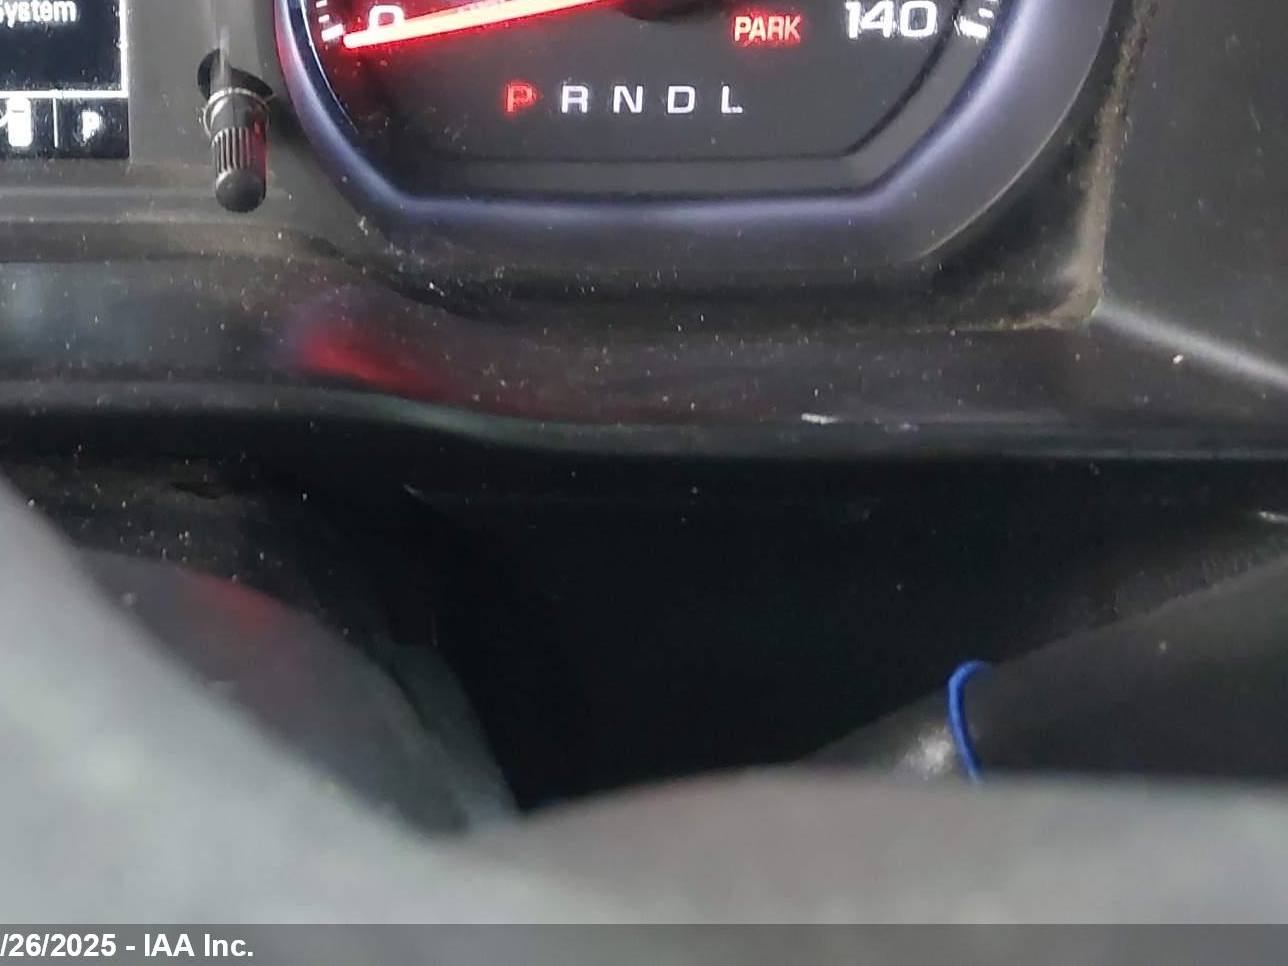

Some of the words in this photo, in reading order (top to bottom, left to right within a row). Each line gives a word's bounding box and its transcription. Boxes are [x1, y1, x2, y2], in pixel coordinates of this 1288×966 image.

[734, 15, 801, 42] PARK
[845, 0, 938, 38] 140
[507, 83, 535, 112] P
[561, 86, 590, 113] R
[614, 86, 643, 113] N
[668, 86, 697, 113] D
[721, 86, 744, 113] L
